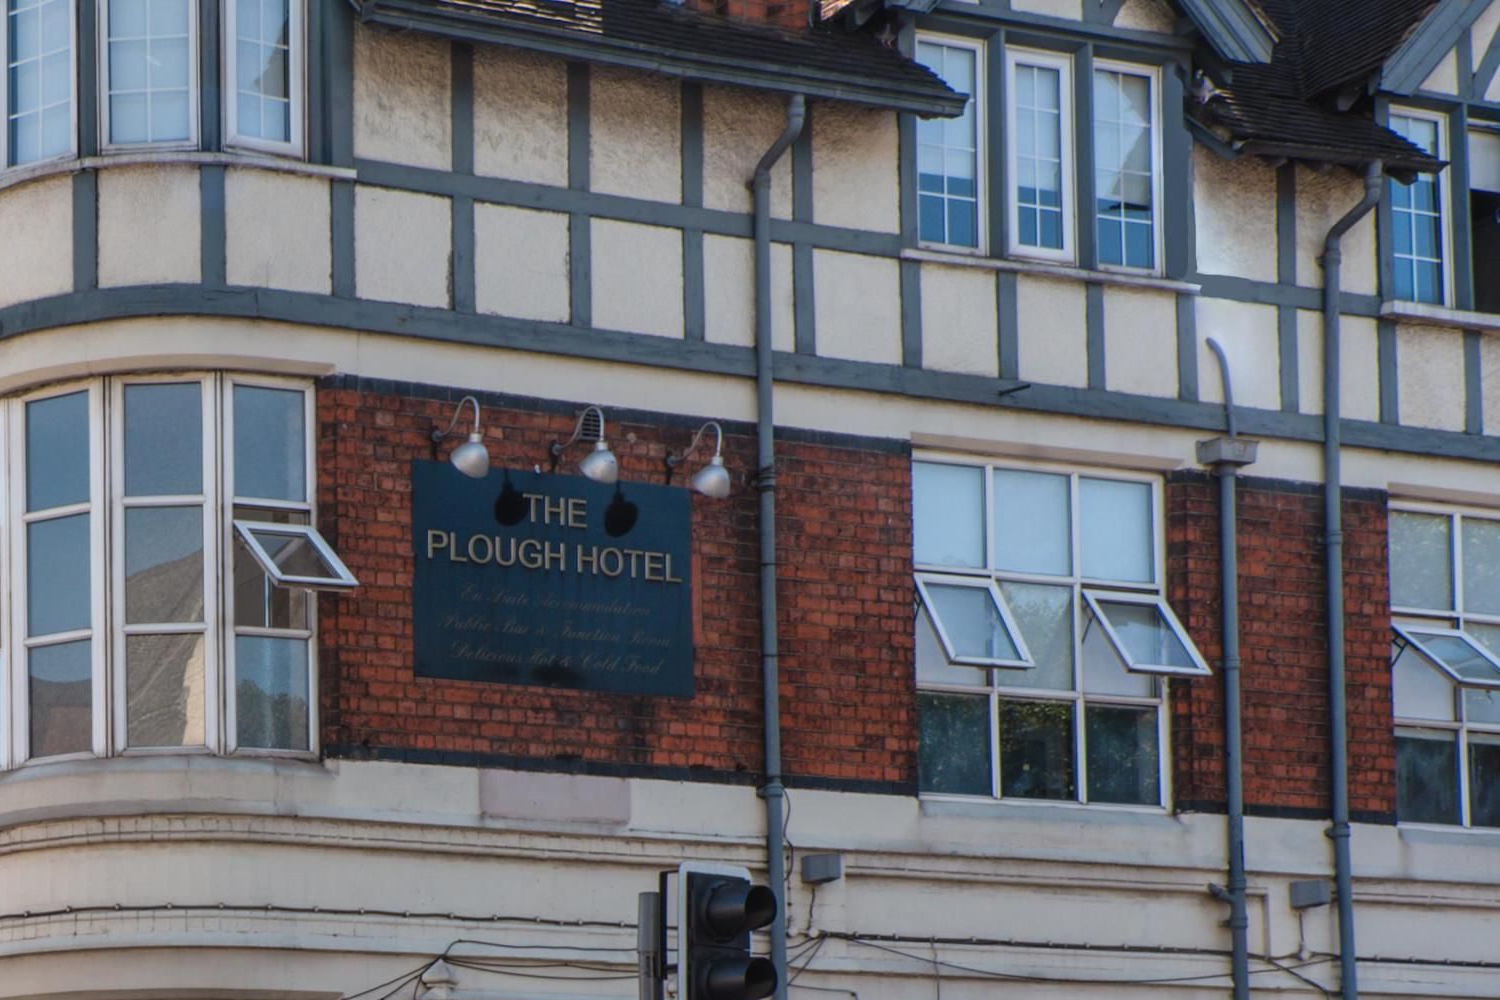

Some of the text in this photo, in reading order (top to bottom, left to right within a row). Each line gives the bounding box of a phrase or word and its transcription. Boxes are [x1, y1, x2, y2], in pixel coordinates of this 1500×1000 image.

[522, 493, 588, 529] THE
[427, 529, 683, 583] PLOUGH HOTEL
[555, 620, 621, 642] Function
[528, 647, 556, 667] Hot
[580, 651, 620, 673] Cold
[622, 655, 665, 675] Food
